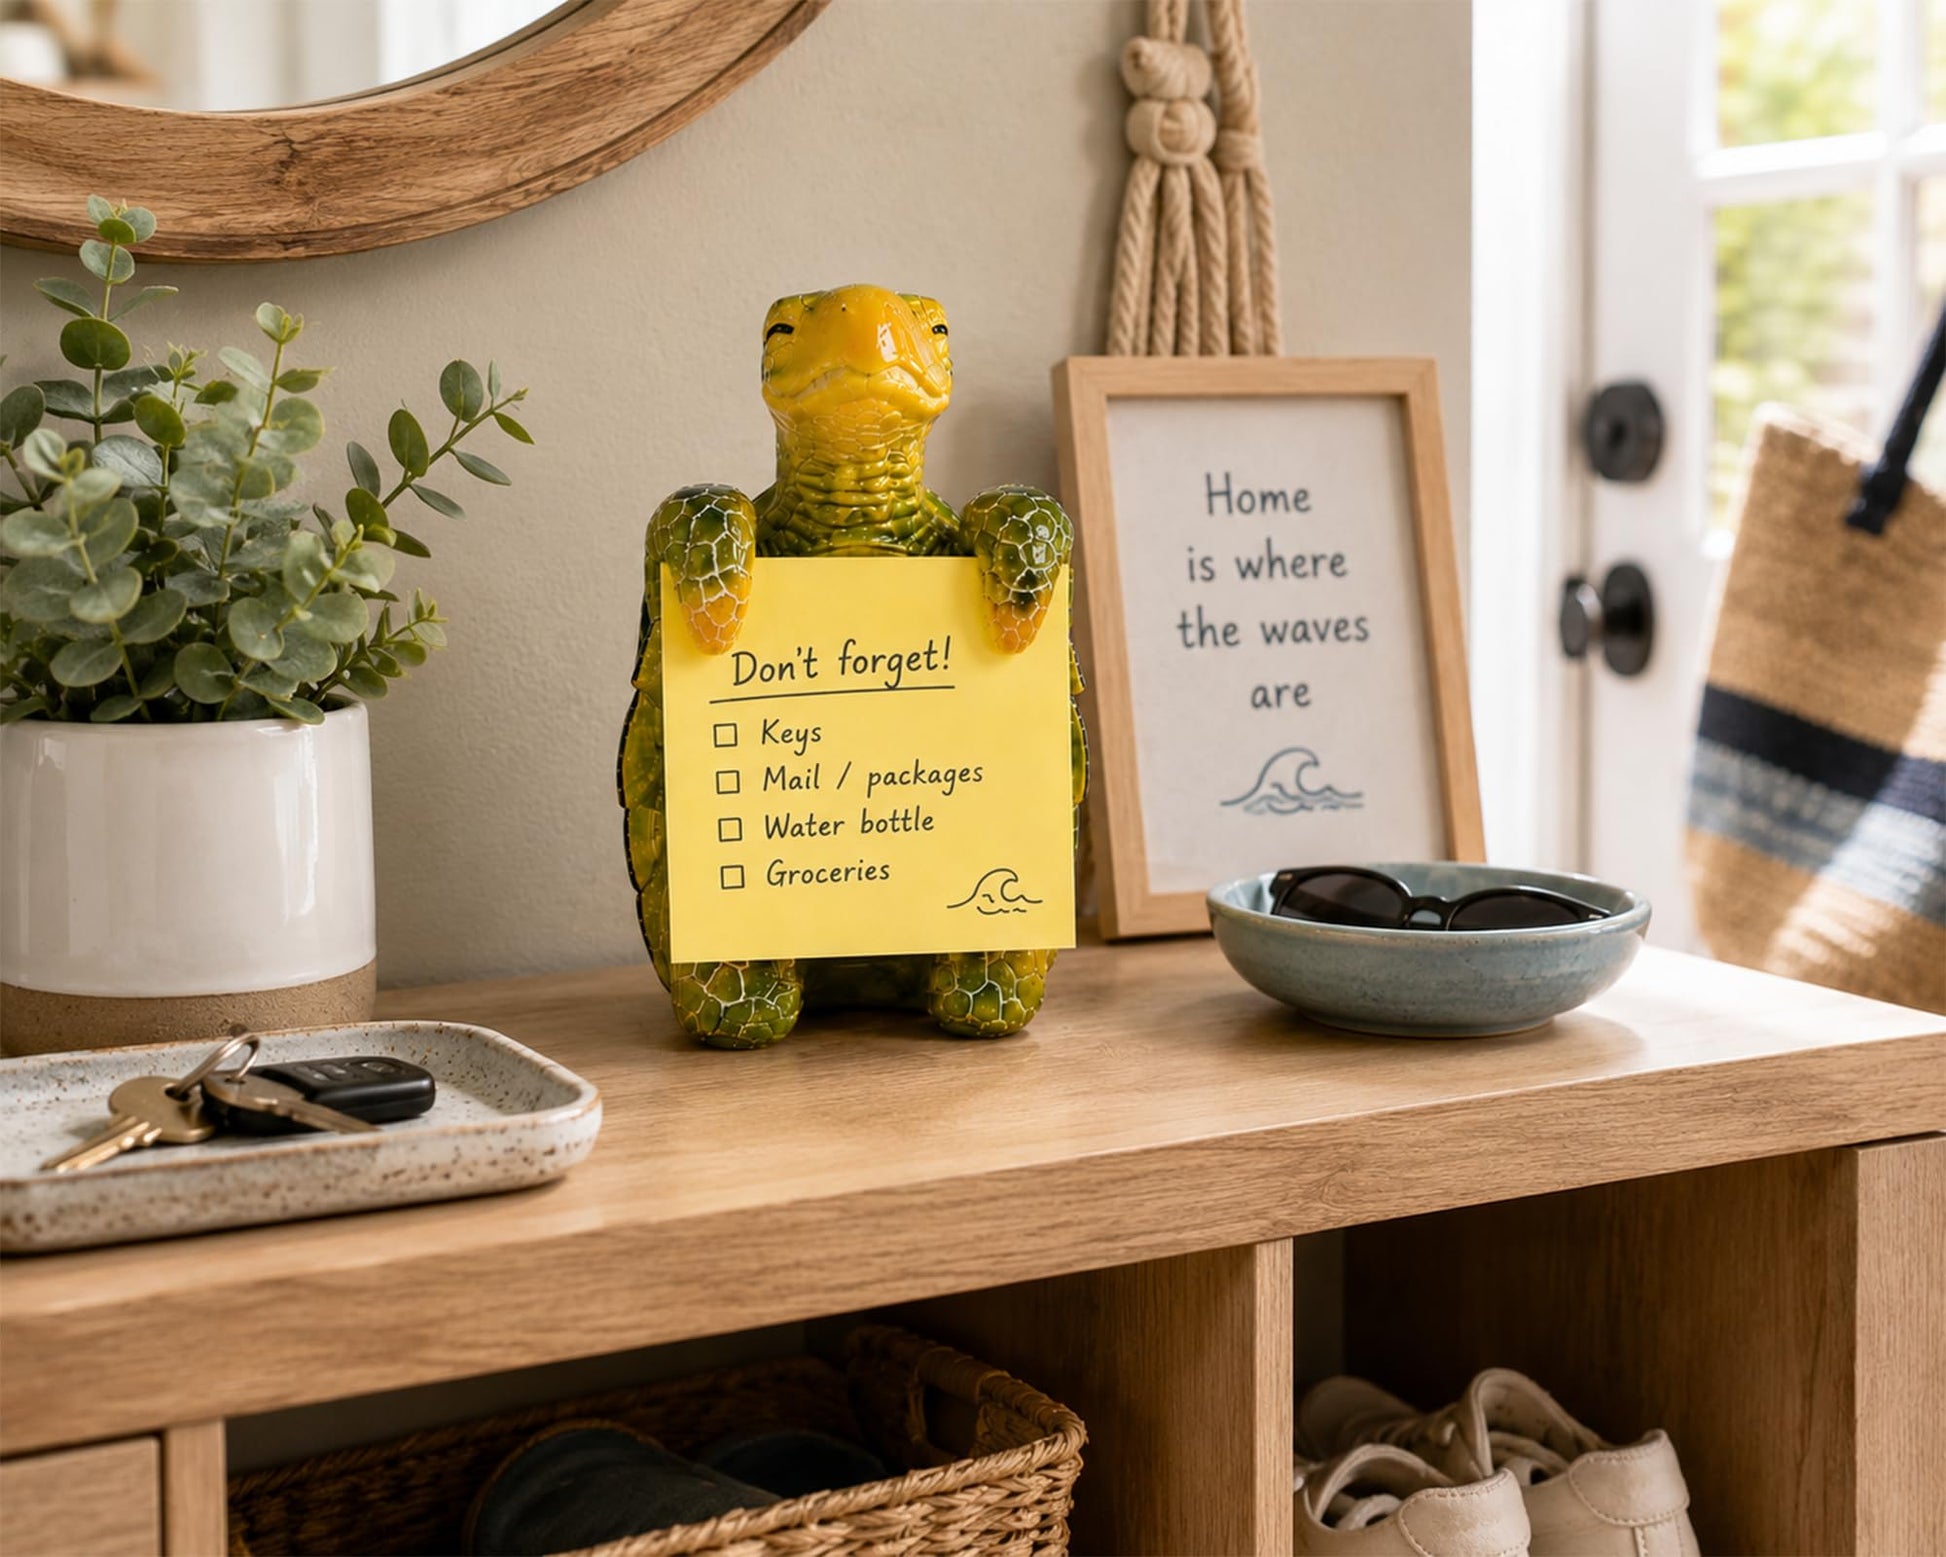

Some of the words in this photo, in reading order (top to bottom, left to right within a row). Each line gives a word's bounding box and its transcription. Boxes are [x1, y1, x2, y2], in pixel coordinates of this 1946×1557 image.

[1206, 472, 1310, 515] Home
[1188, 546, 1215, 582] is
[1235, 537, 1347, 579] where
[1177, 605, 1240, 648] the
[1261, 617, 1368, 644] waves
[732, 647, 818, 686] Don't
[839, 635, 952, 689] forget!
[1251, 684, 1310, 709] are
[762, 719, 821, 756] Keys
[764, 763, 819, 791] Mail
[837, 761, 851, 789] /
[867, 759, 982, 798] packages
[765, 813, 844, 839] Water
[861, 805, 934, 833] bottle
[767, 859, 889, 886] Groceries
